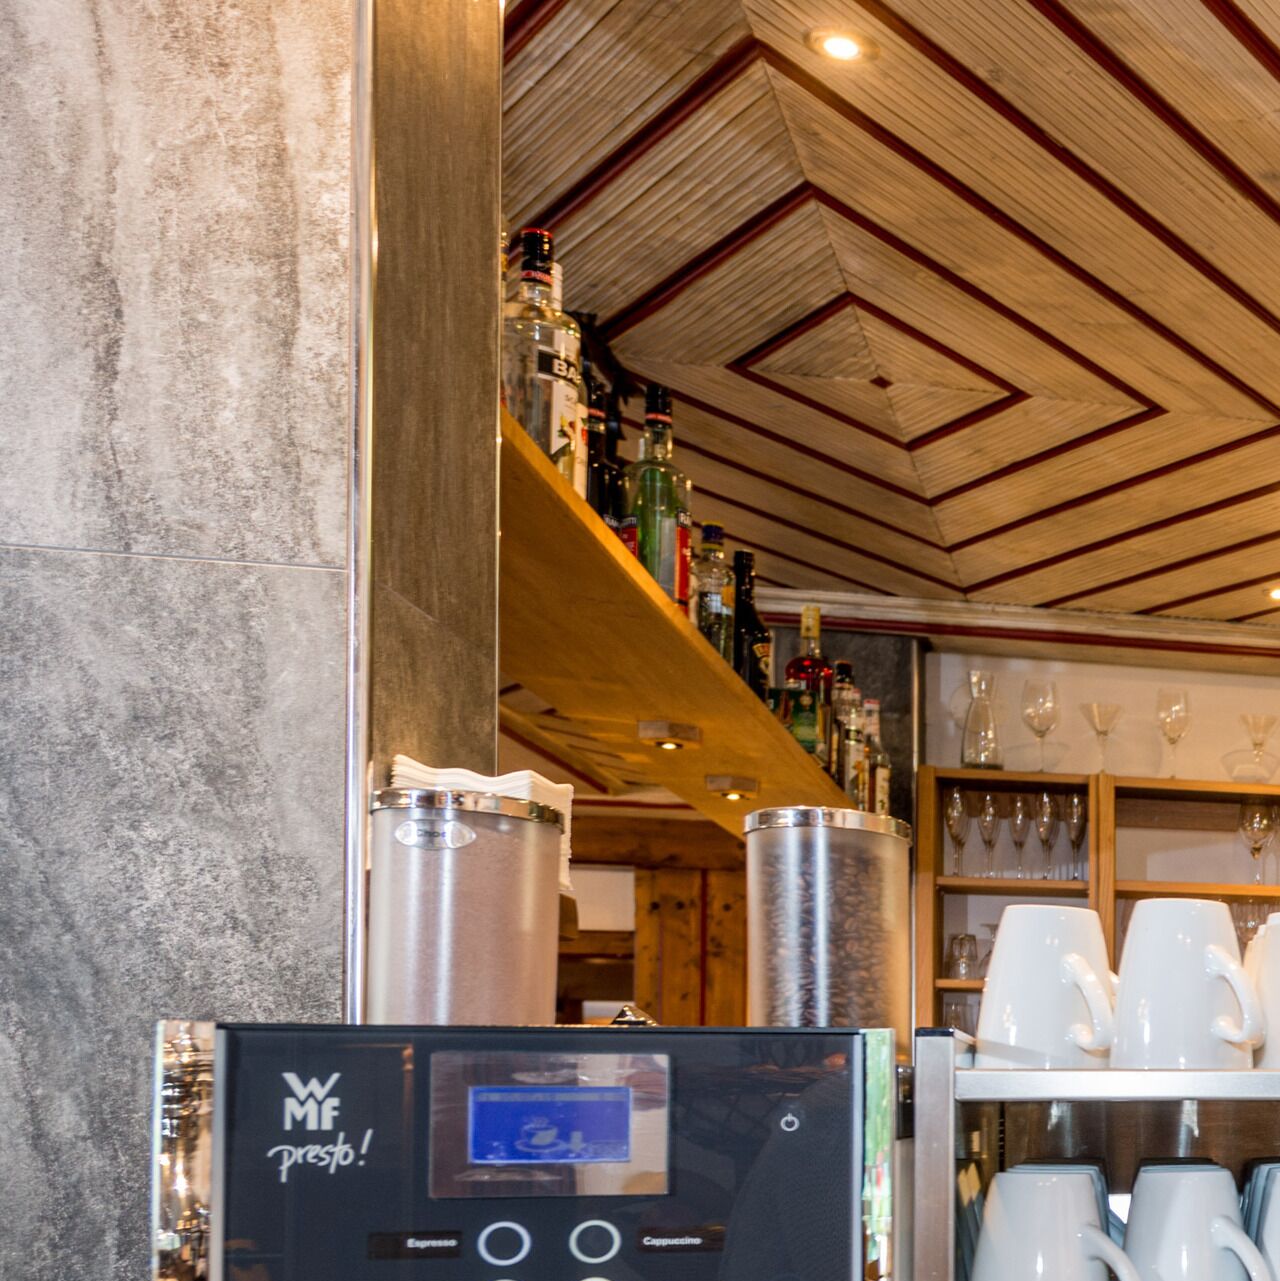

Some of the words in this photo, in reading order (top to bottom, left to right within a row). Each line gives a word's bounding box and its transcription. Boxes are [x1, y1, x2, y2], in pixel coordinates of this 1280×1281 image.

[281, 1072, 341, 1131] WMF
[266, 1128, 374, 1184] presto!
[406, 1238, 458, 1249] Espresso
[643, 1236, 703, 1247] Cappuccino
